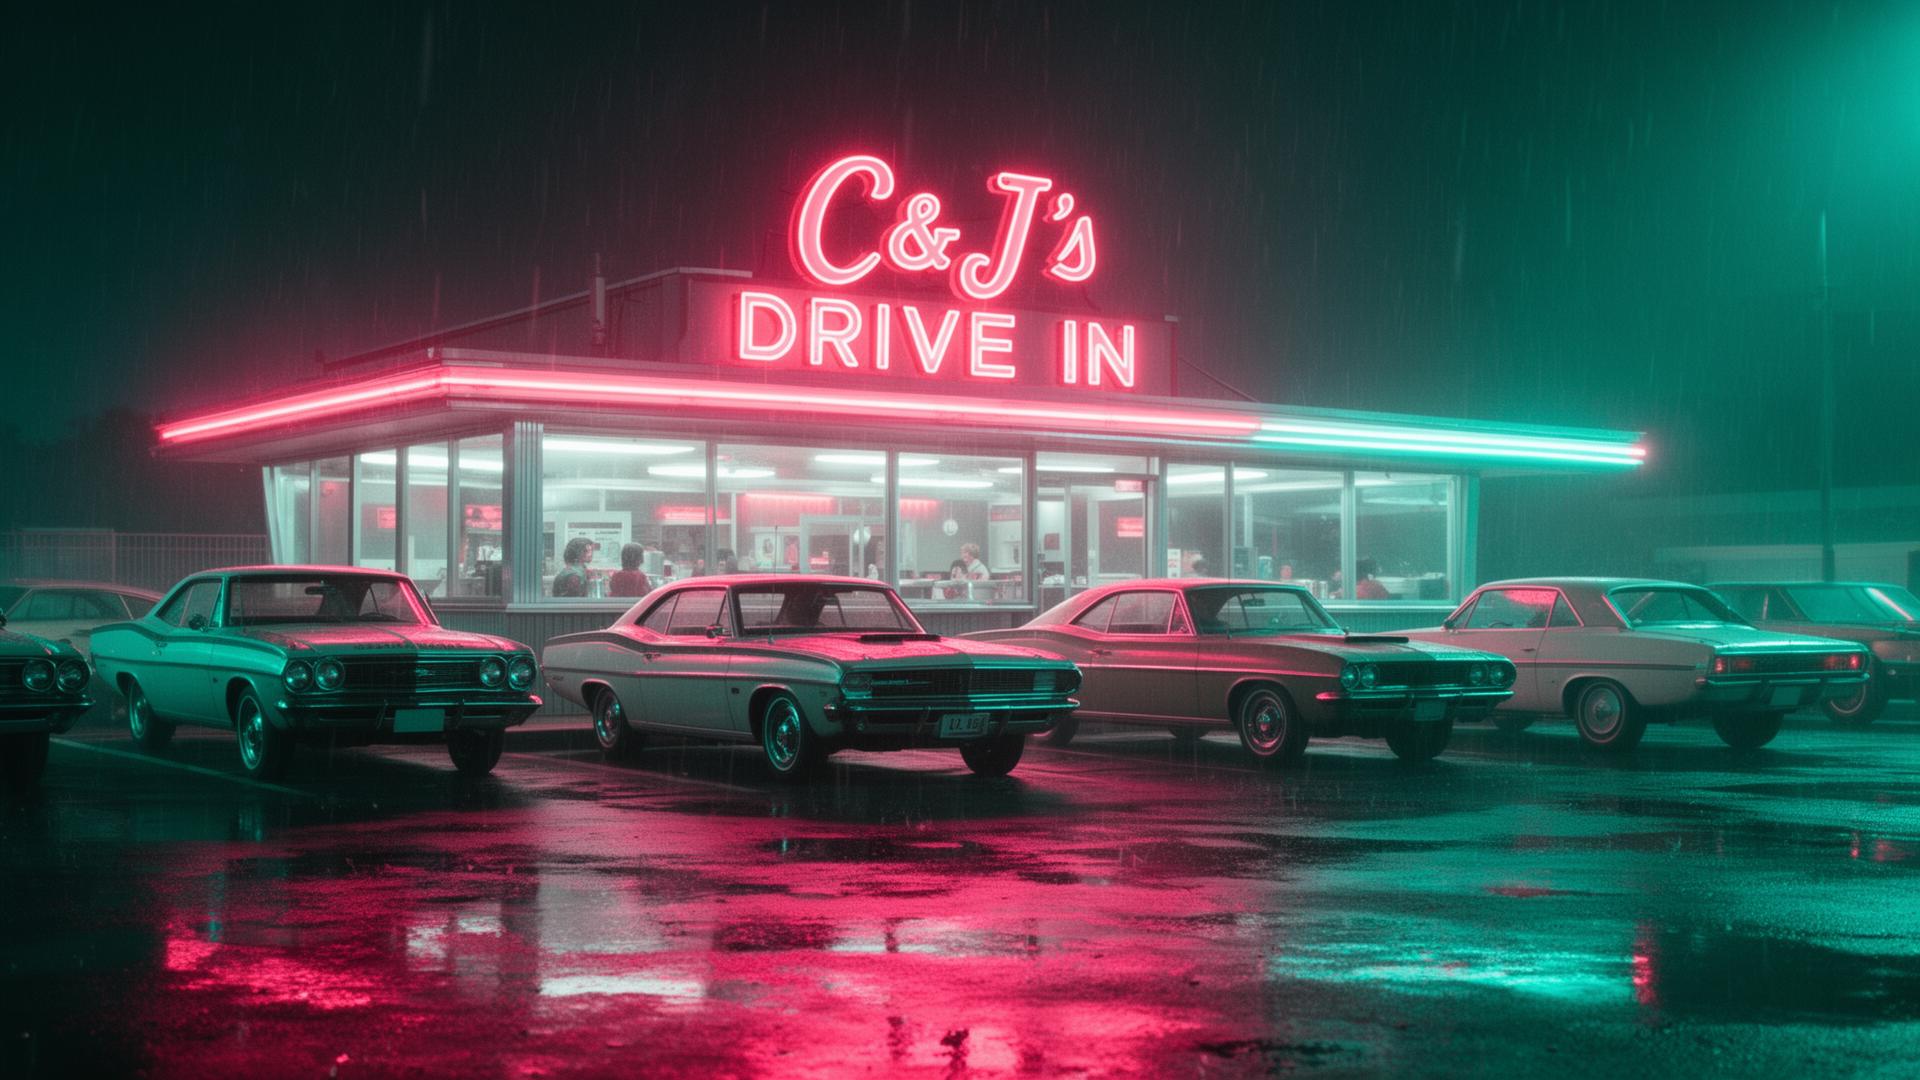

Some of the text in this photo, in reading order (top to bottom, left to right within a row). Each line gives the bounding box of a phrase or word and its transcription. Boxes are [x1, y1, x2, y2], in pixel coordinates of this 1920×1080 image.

[793, 154, 1098, 301] C&J's
[737, 290, 1136, 389] DRIVE IN
